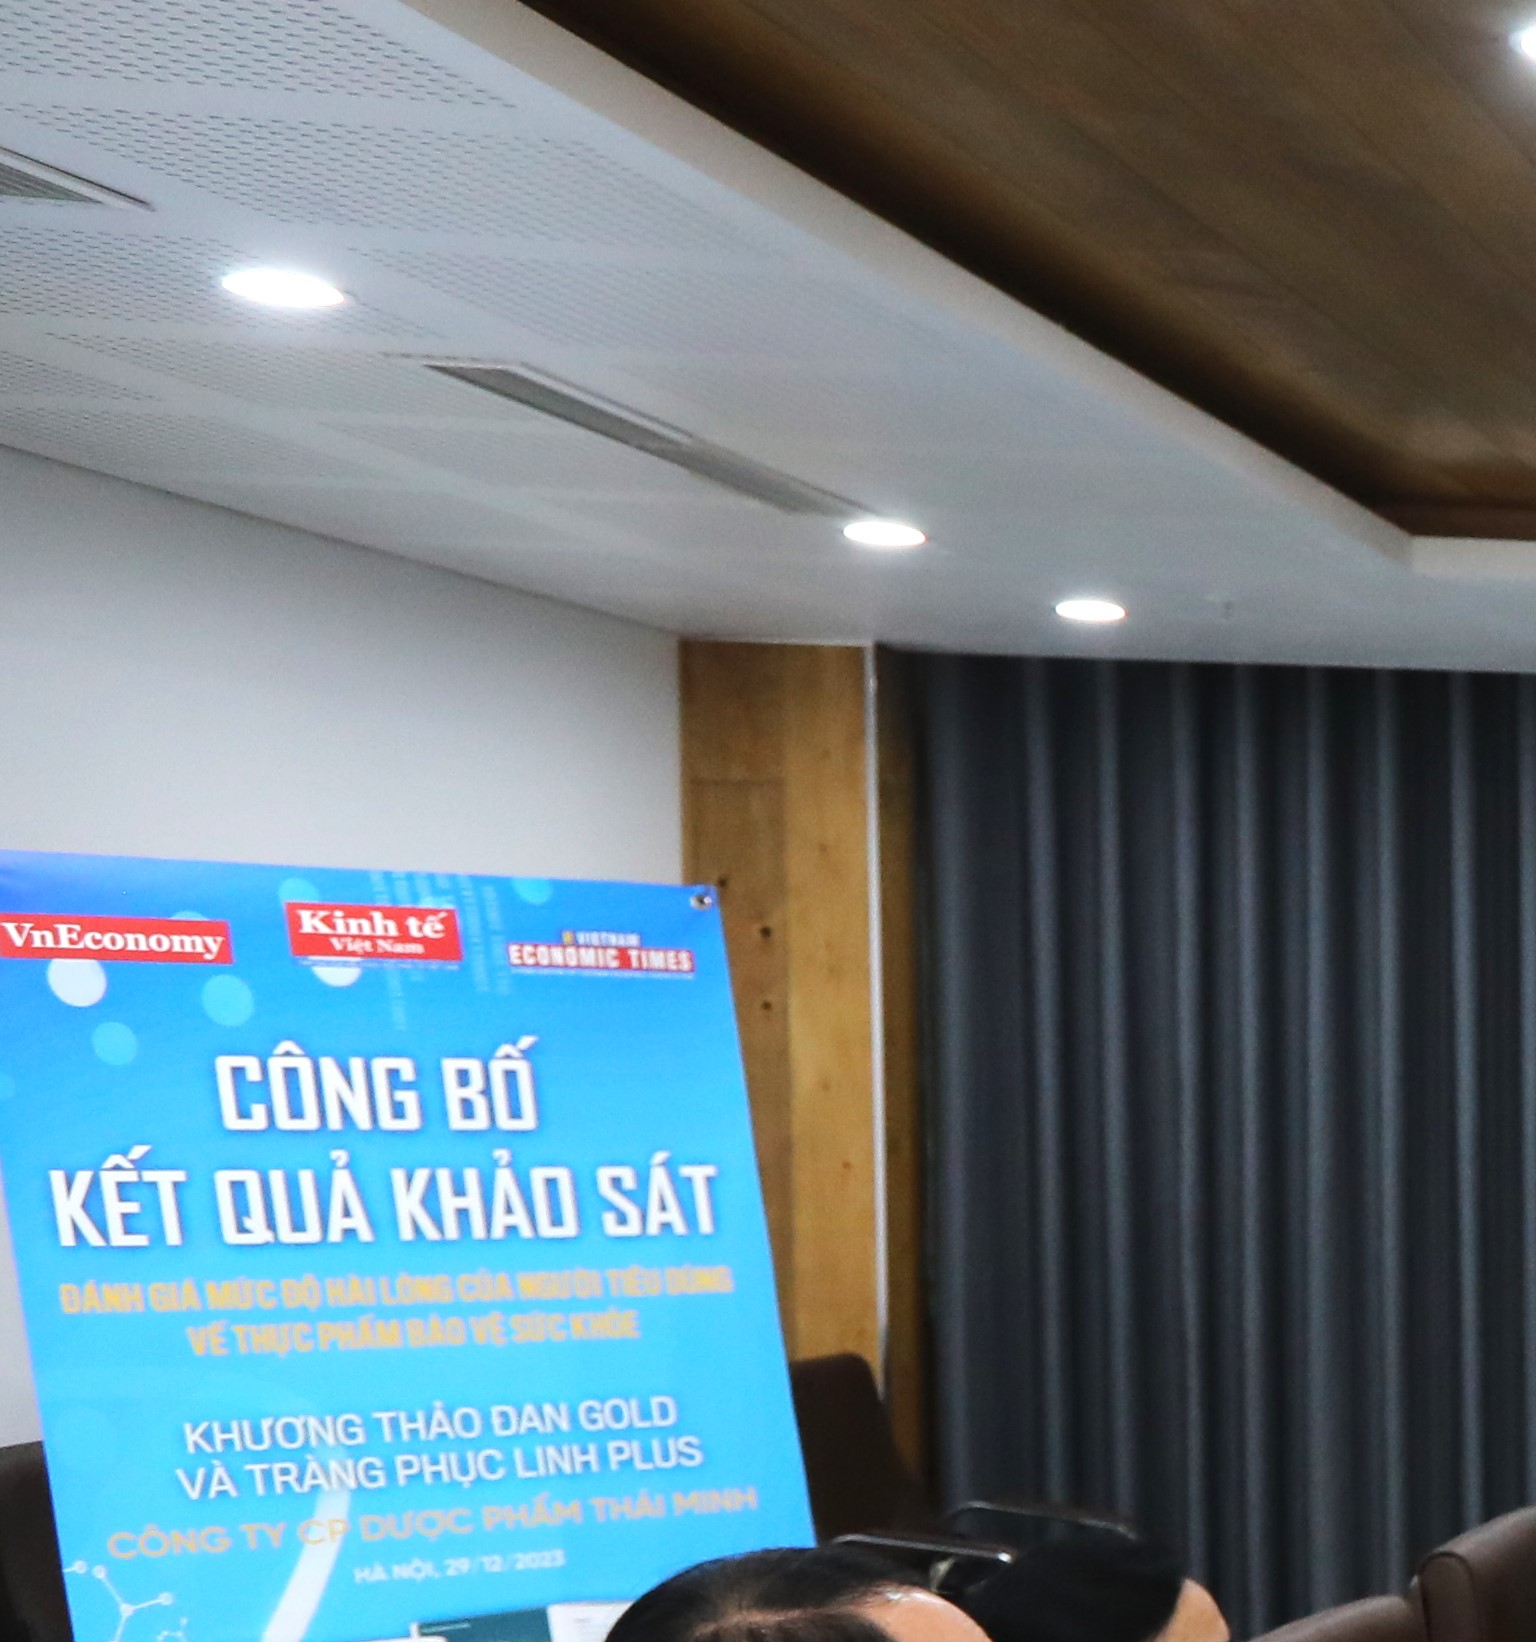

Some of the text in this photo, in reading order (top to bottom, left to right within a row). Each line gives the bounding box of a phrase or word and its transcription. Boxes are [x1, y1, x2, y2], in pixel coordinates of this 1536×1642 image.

[2, 921, 224, 961] VnEconomy
[297, 908, 449, 939] Kinh tế
[330, 937, 426, 956] Việt Nam
[508, 944, 693, 973] ECONOMIC TIMES
[214, 1034, 539, 1131] CÔNG BỐ
[48, 1144, 719, 1248] KẾT QUẢ KHẢO SÁT
[183, 1395, 679, 1455] KHƯƠNG THẢO ĐAN GOLD
[176, 1435, 704, 1501] VÀ TRÀNG PHỤC LINH PLUS
[107, 1486, 759, 1560] CÔNG TY CP DƯỢC PHẨM THÁI MINH
